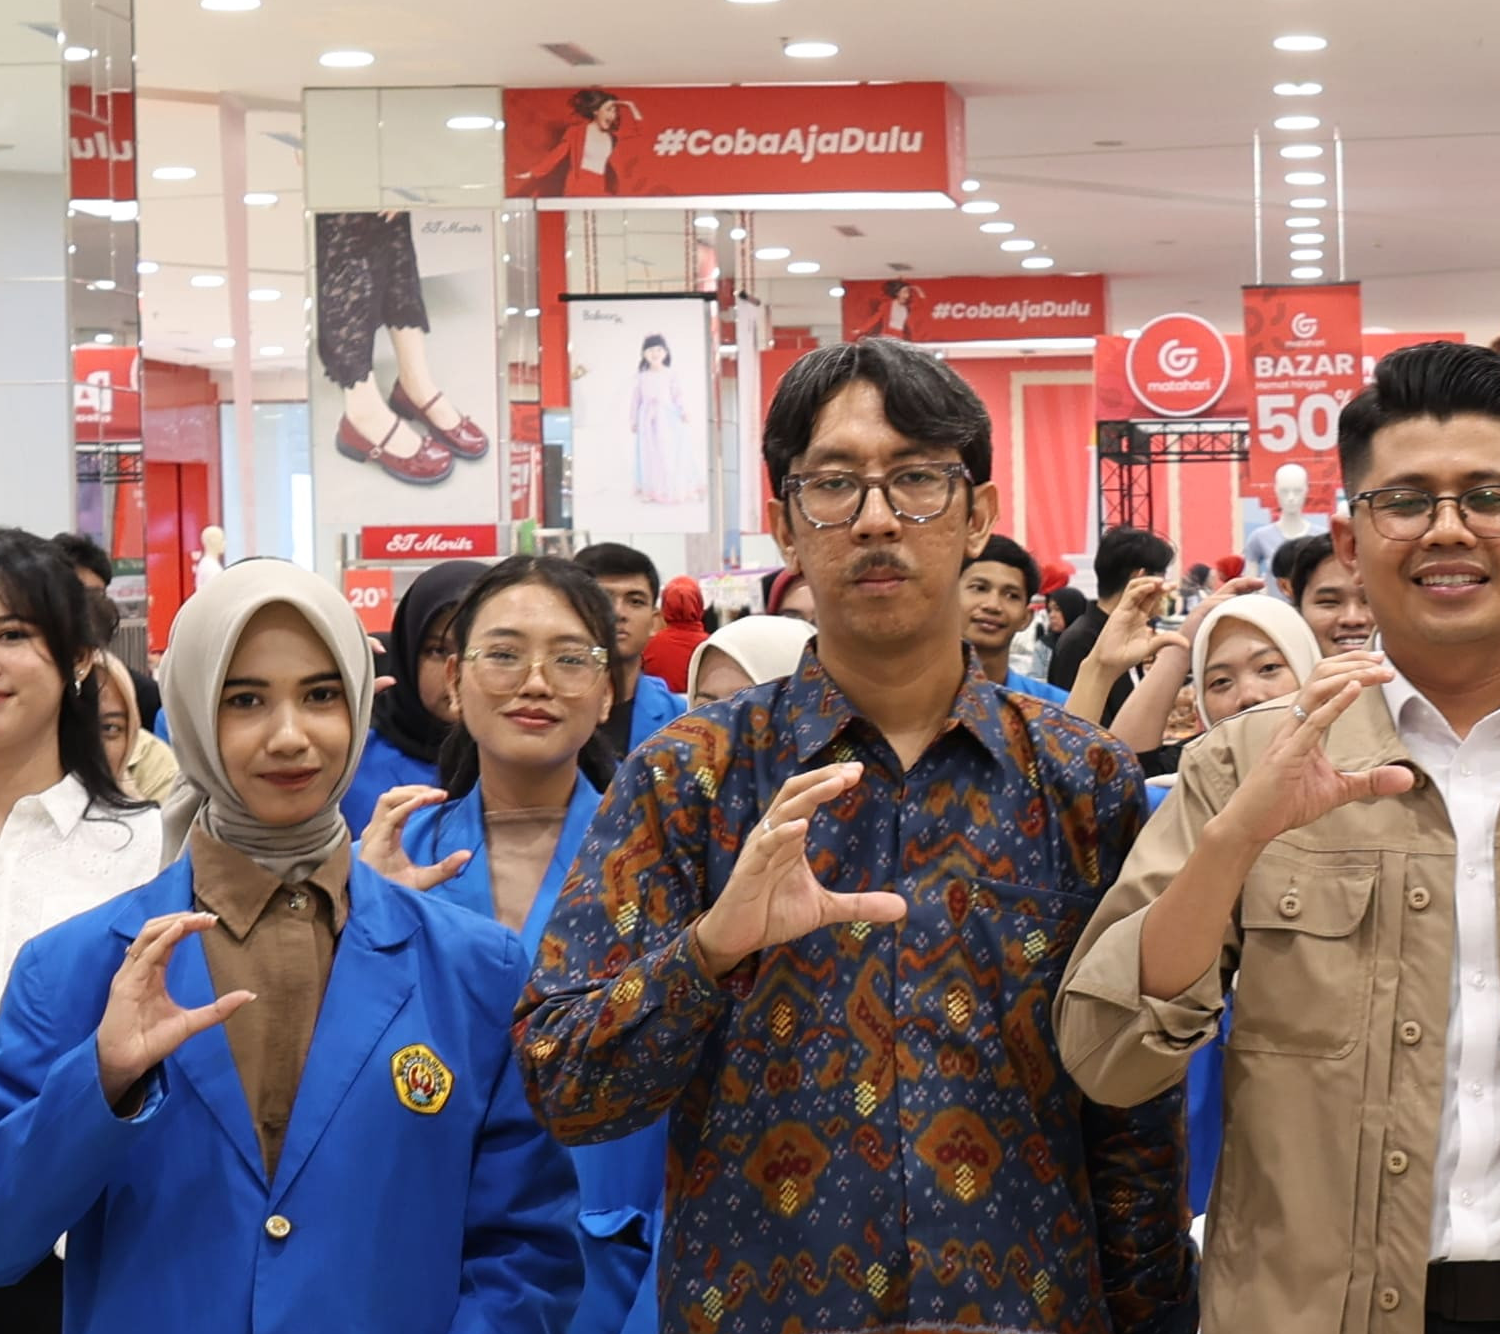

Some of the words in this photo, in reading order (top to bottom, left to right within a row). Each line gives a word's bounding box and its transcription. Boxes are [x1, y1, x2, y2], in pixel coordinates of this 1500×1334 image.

[654, 125, 923, 163] #CobaAjaDulu
[932, 300, 1091, 323] #CobaAjaDulu
[1255, 353, 1354, 377] BAZAR
[1147, 378, 1211, 392] matahari
